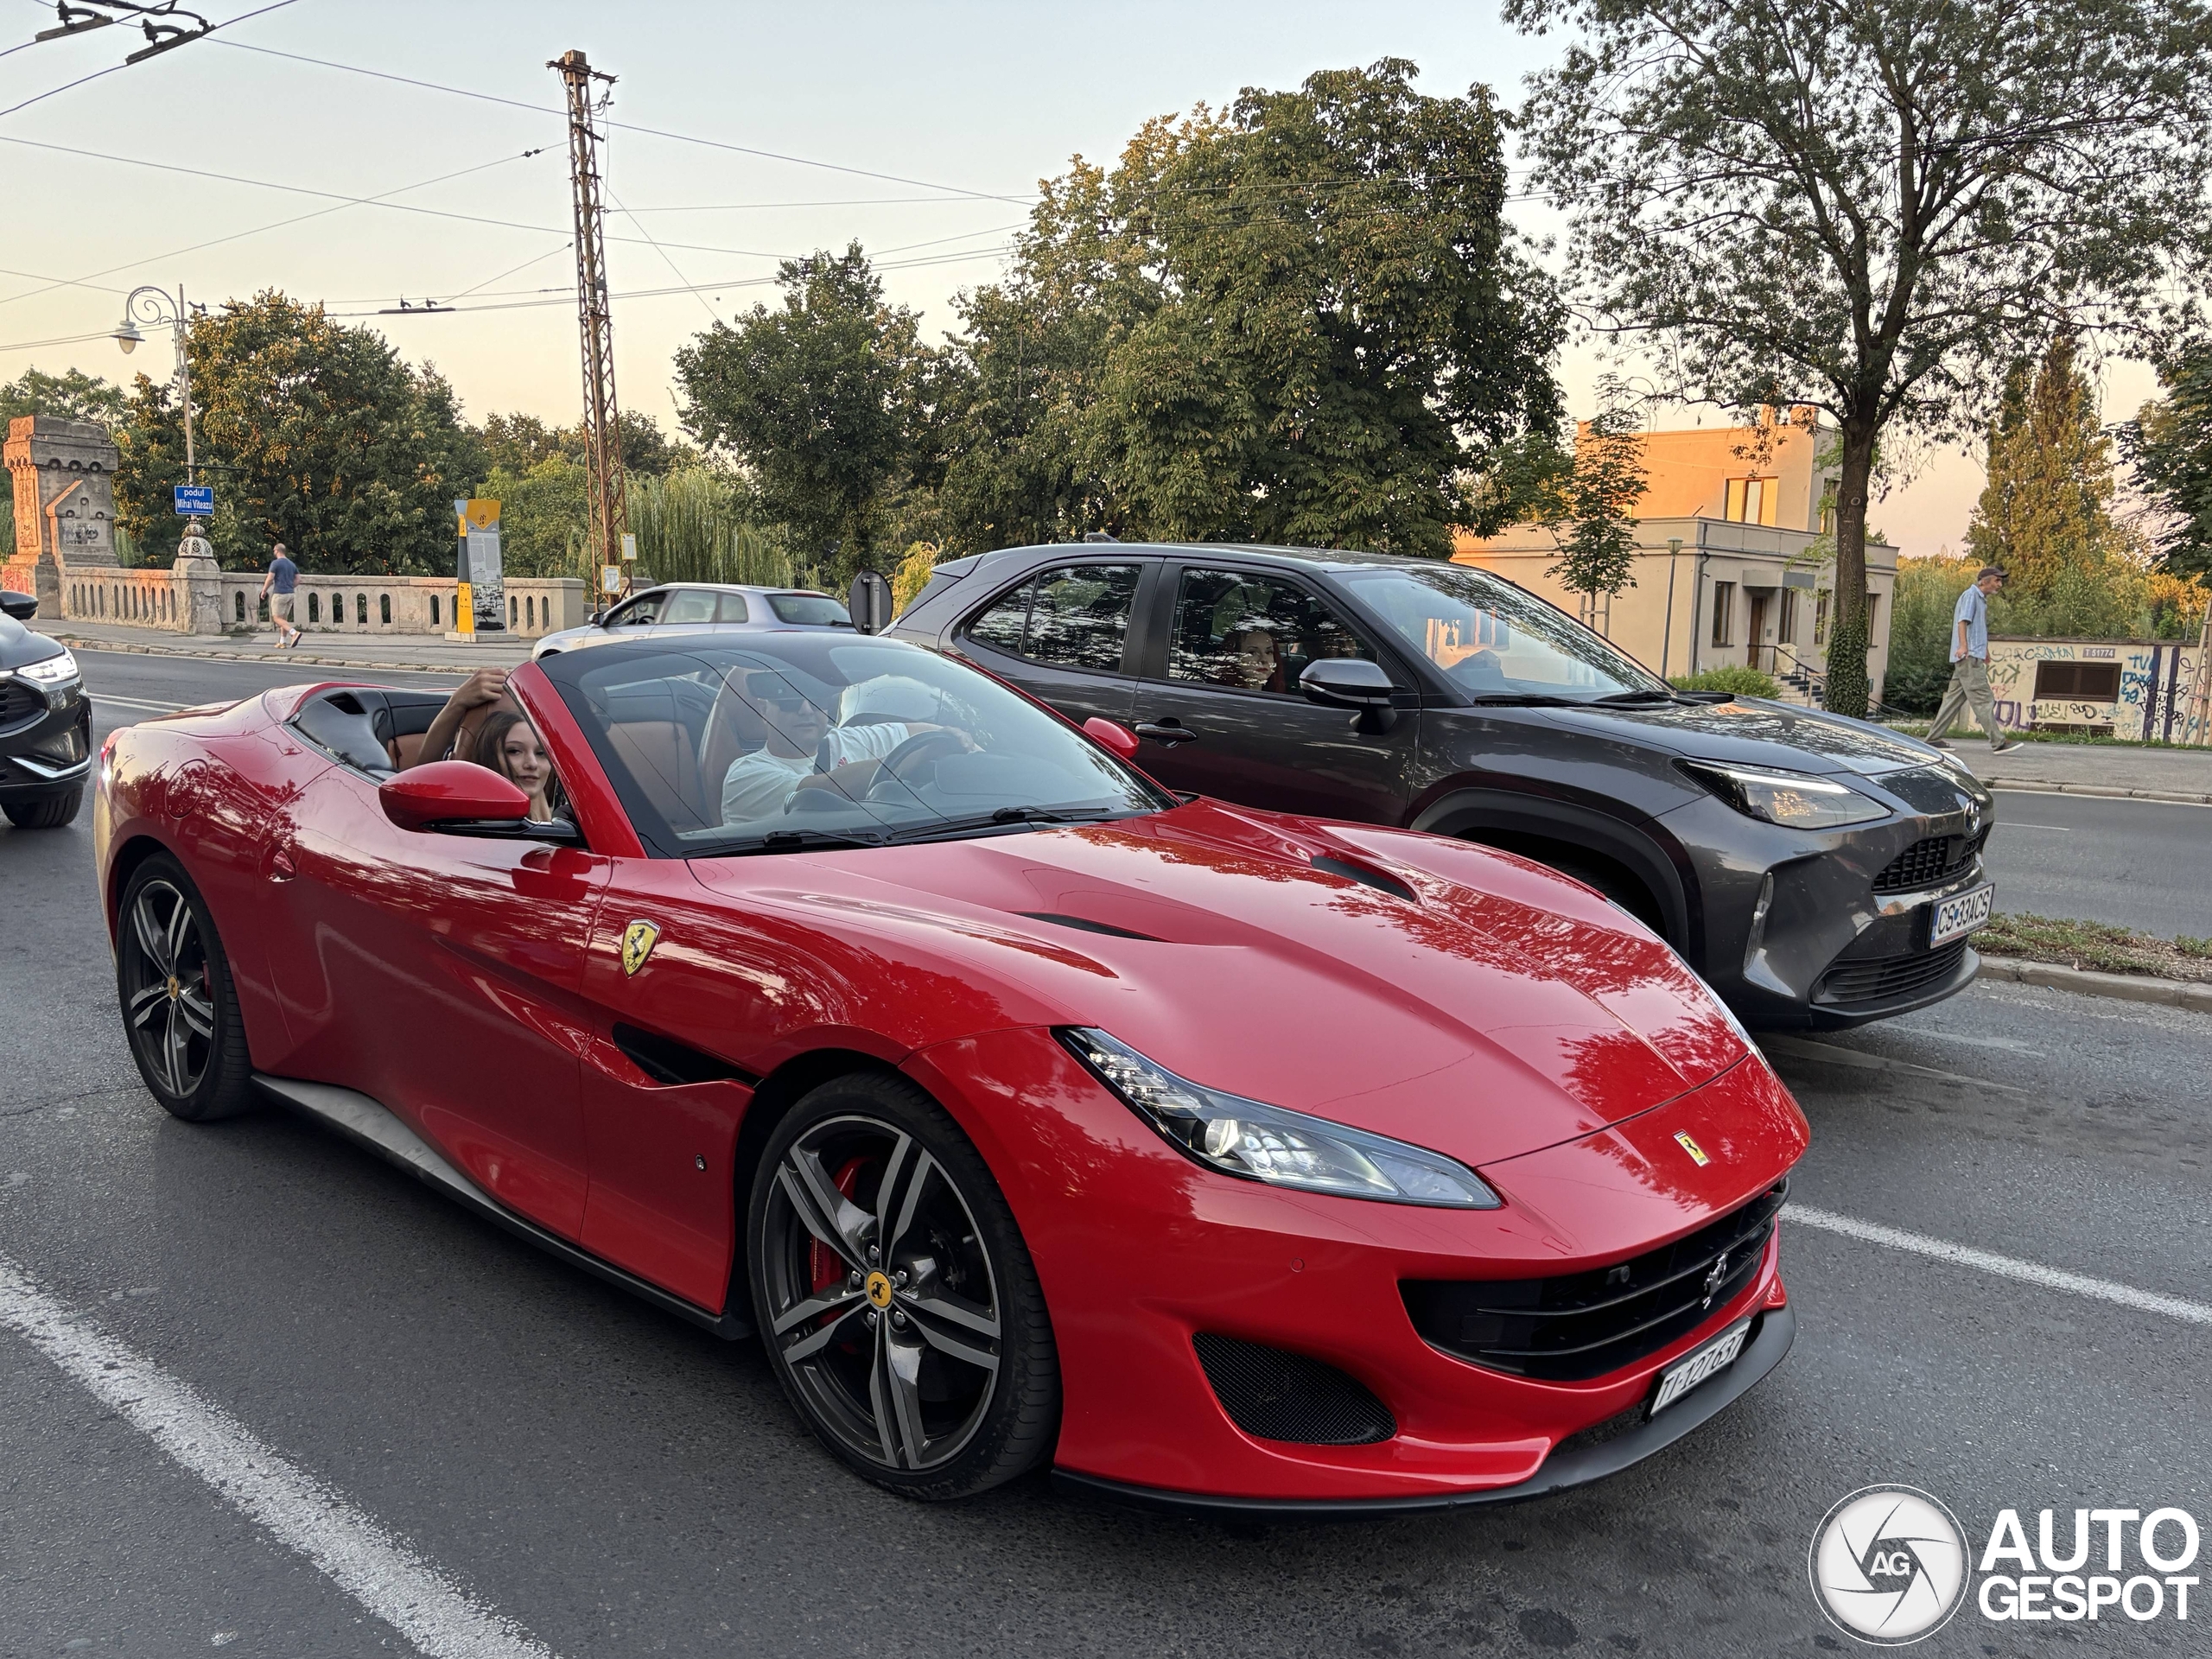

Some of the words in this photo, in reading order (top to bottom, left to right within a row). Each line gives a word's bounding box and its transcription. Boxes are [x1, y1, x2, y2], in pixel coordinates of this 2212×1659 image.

[184, 488, 205, 498] podul
[177, 499, 192, 508] Mihai
[2085, 648, 2091, 657] T
[2091, 648, 2113, 658] 51774
[1938, 903, 1955, 935] CS
